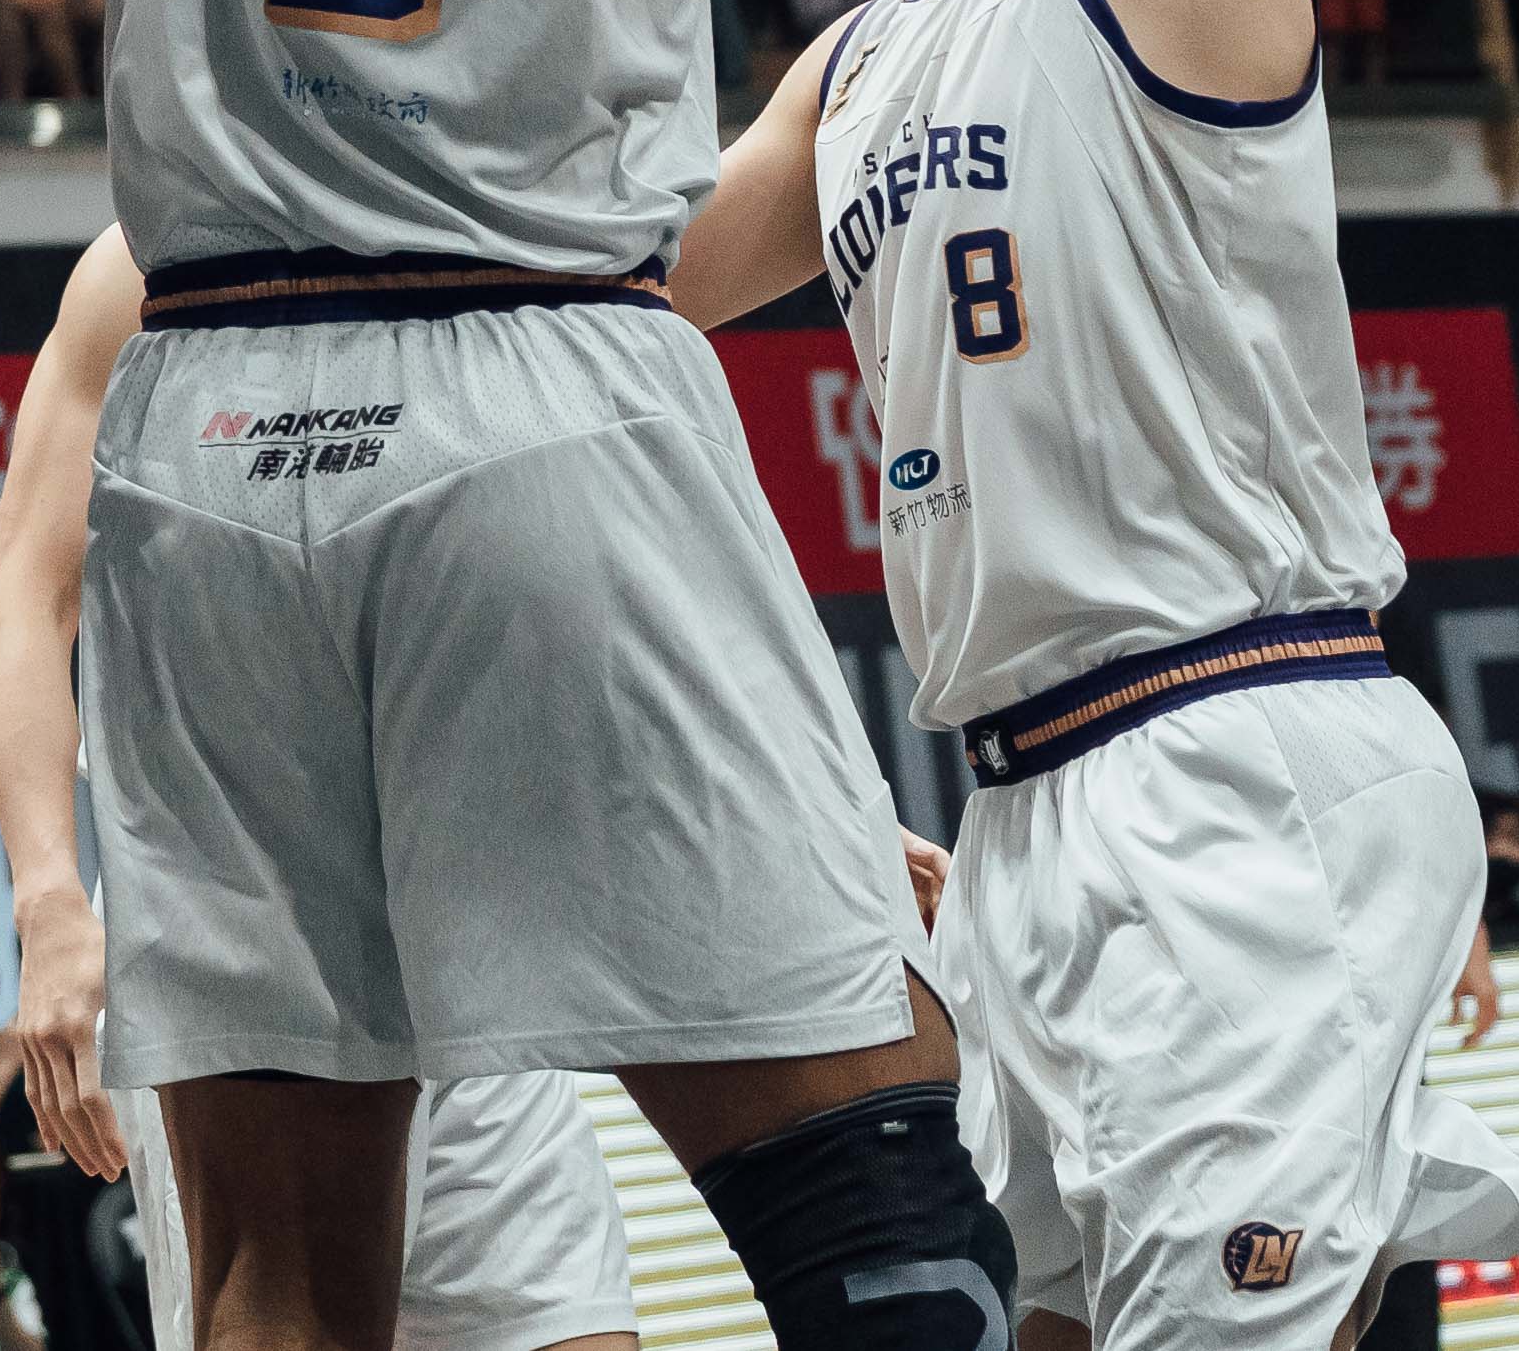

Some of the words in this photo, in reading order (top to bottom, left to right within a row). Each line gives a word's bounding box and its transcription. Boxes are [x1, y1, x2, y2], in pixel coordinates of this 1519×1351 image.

[944, 227, 1029, 365] 8
[245, 402, 405, 440] NANKANG
[887, 482, 973, 540] 新竹物流
